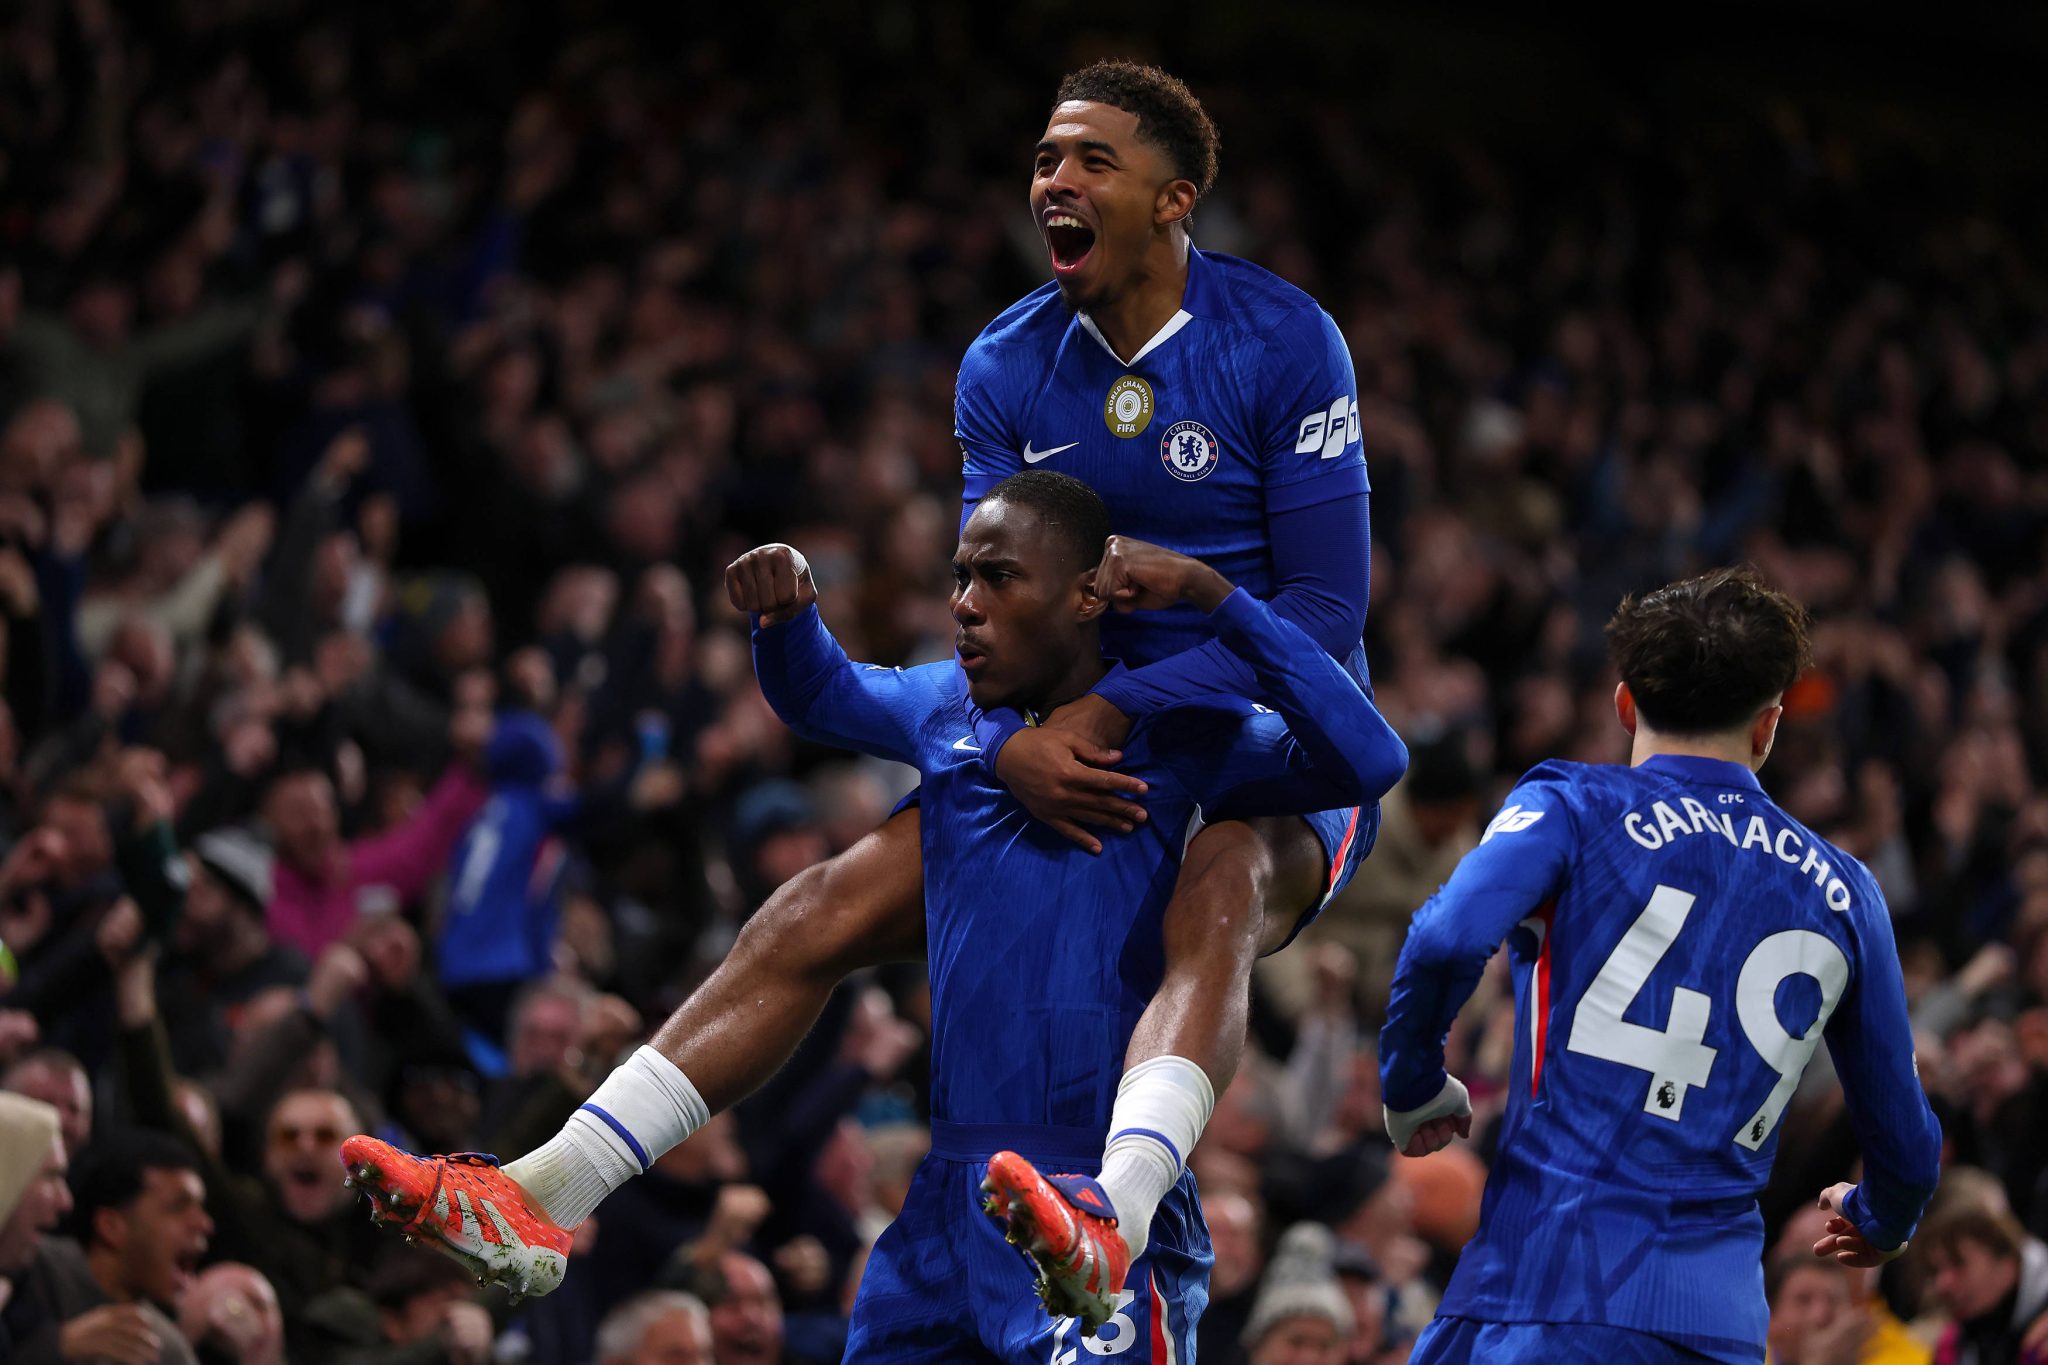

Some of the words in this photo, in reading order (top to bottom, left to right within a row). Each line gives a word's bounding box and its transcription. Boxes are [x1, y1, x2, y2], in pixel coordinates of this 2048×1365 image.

[1108, 385, 1122, 414] WORLD
[1122, 380, 1149, 414] CHAMPIONS
[1116, 423, 1136, 433] FIFA
[1169, 423, 1206, 437] CHELSEA
[1717, 793, 1745, 804] CFC
[1624, 797, 1851, 912] GARNACHO
[1566, 884, 1849, 1152] 49
